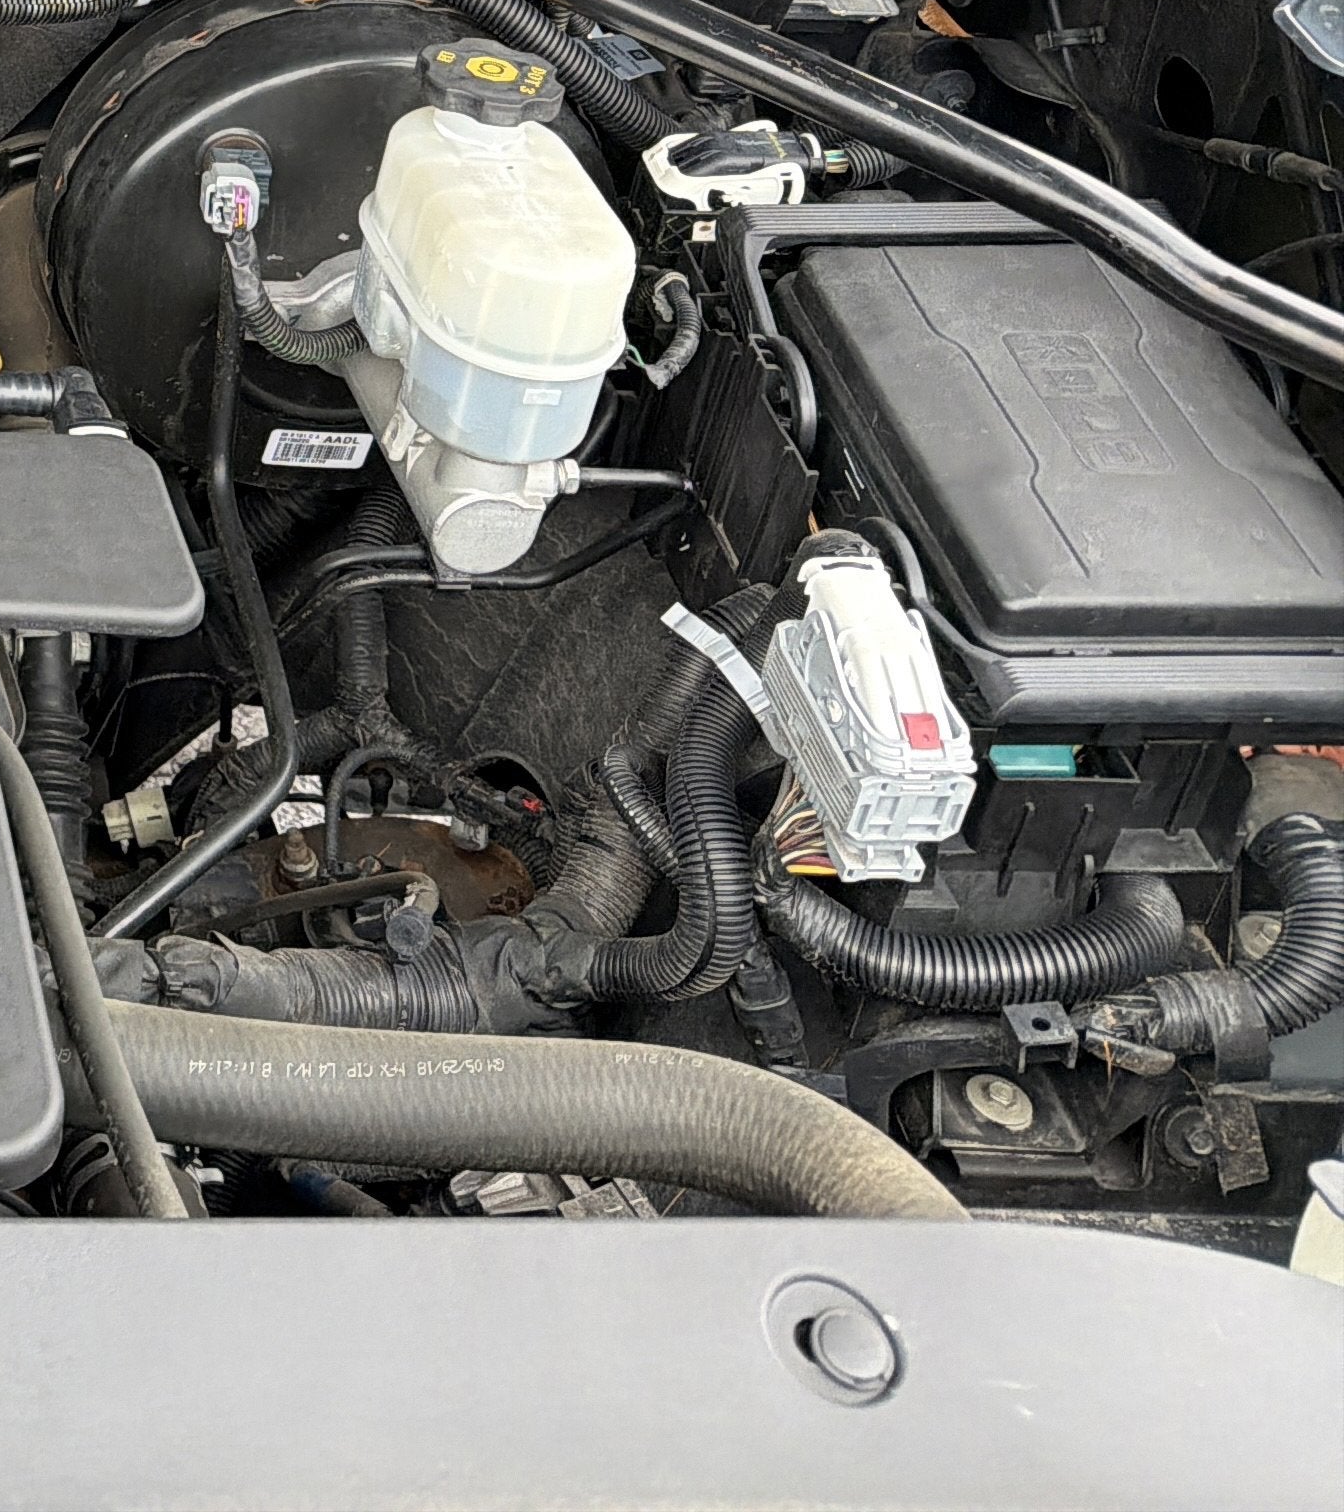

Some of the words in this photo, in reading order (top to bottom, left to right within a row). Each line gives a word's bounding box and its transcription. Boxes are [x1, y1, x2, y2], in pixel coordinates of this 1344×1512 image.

[323, 435, 361, 445] AADL
[347, 1061, 374, 1078] CIP
[417, 1059, 483, 1076] 05/29/18
